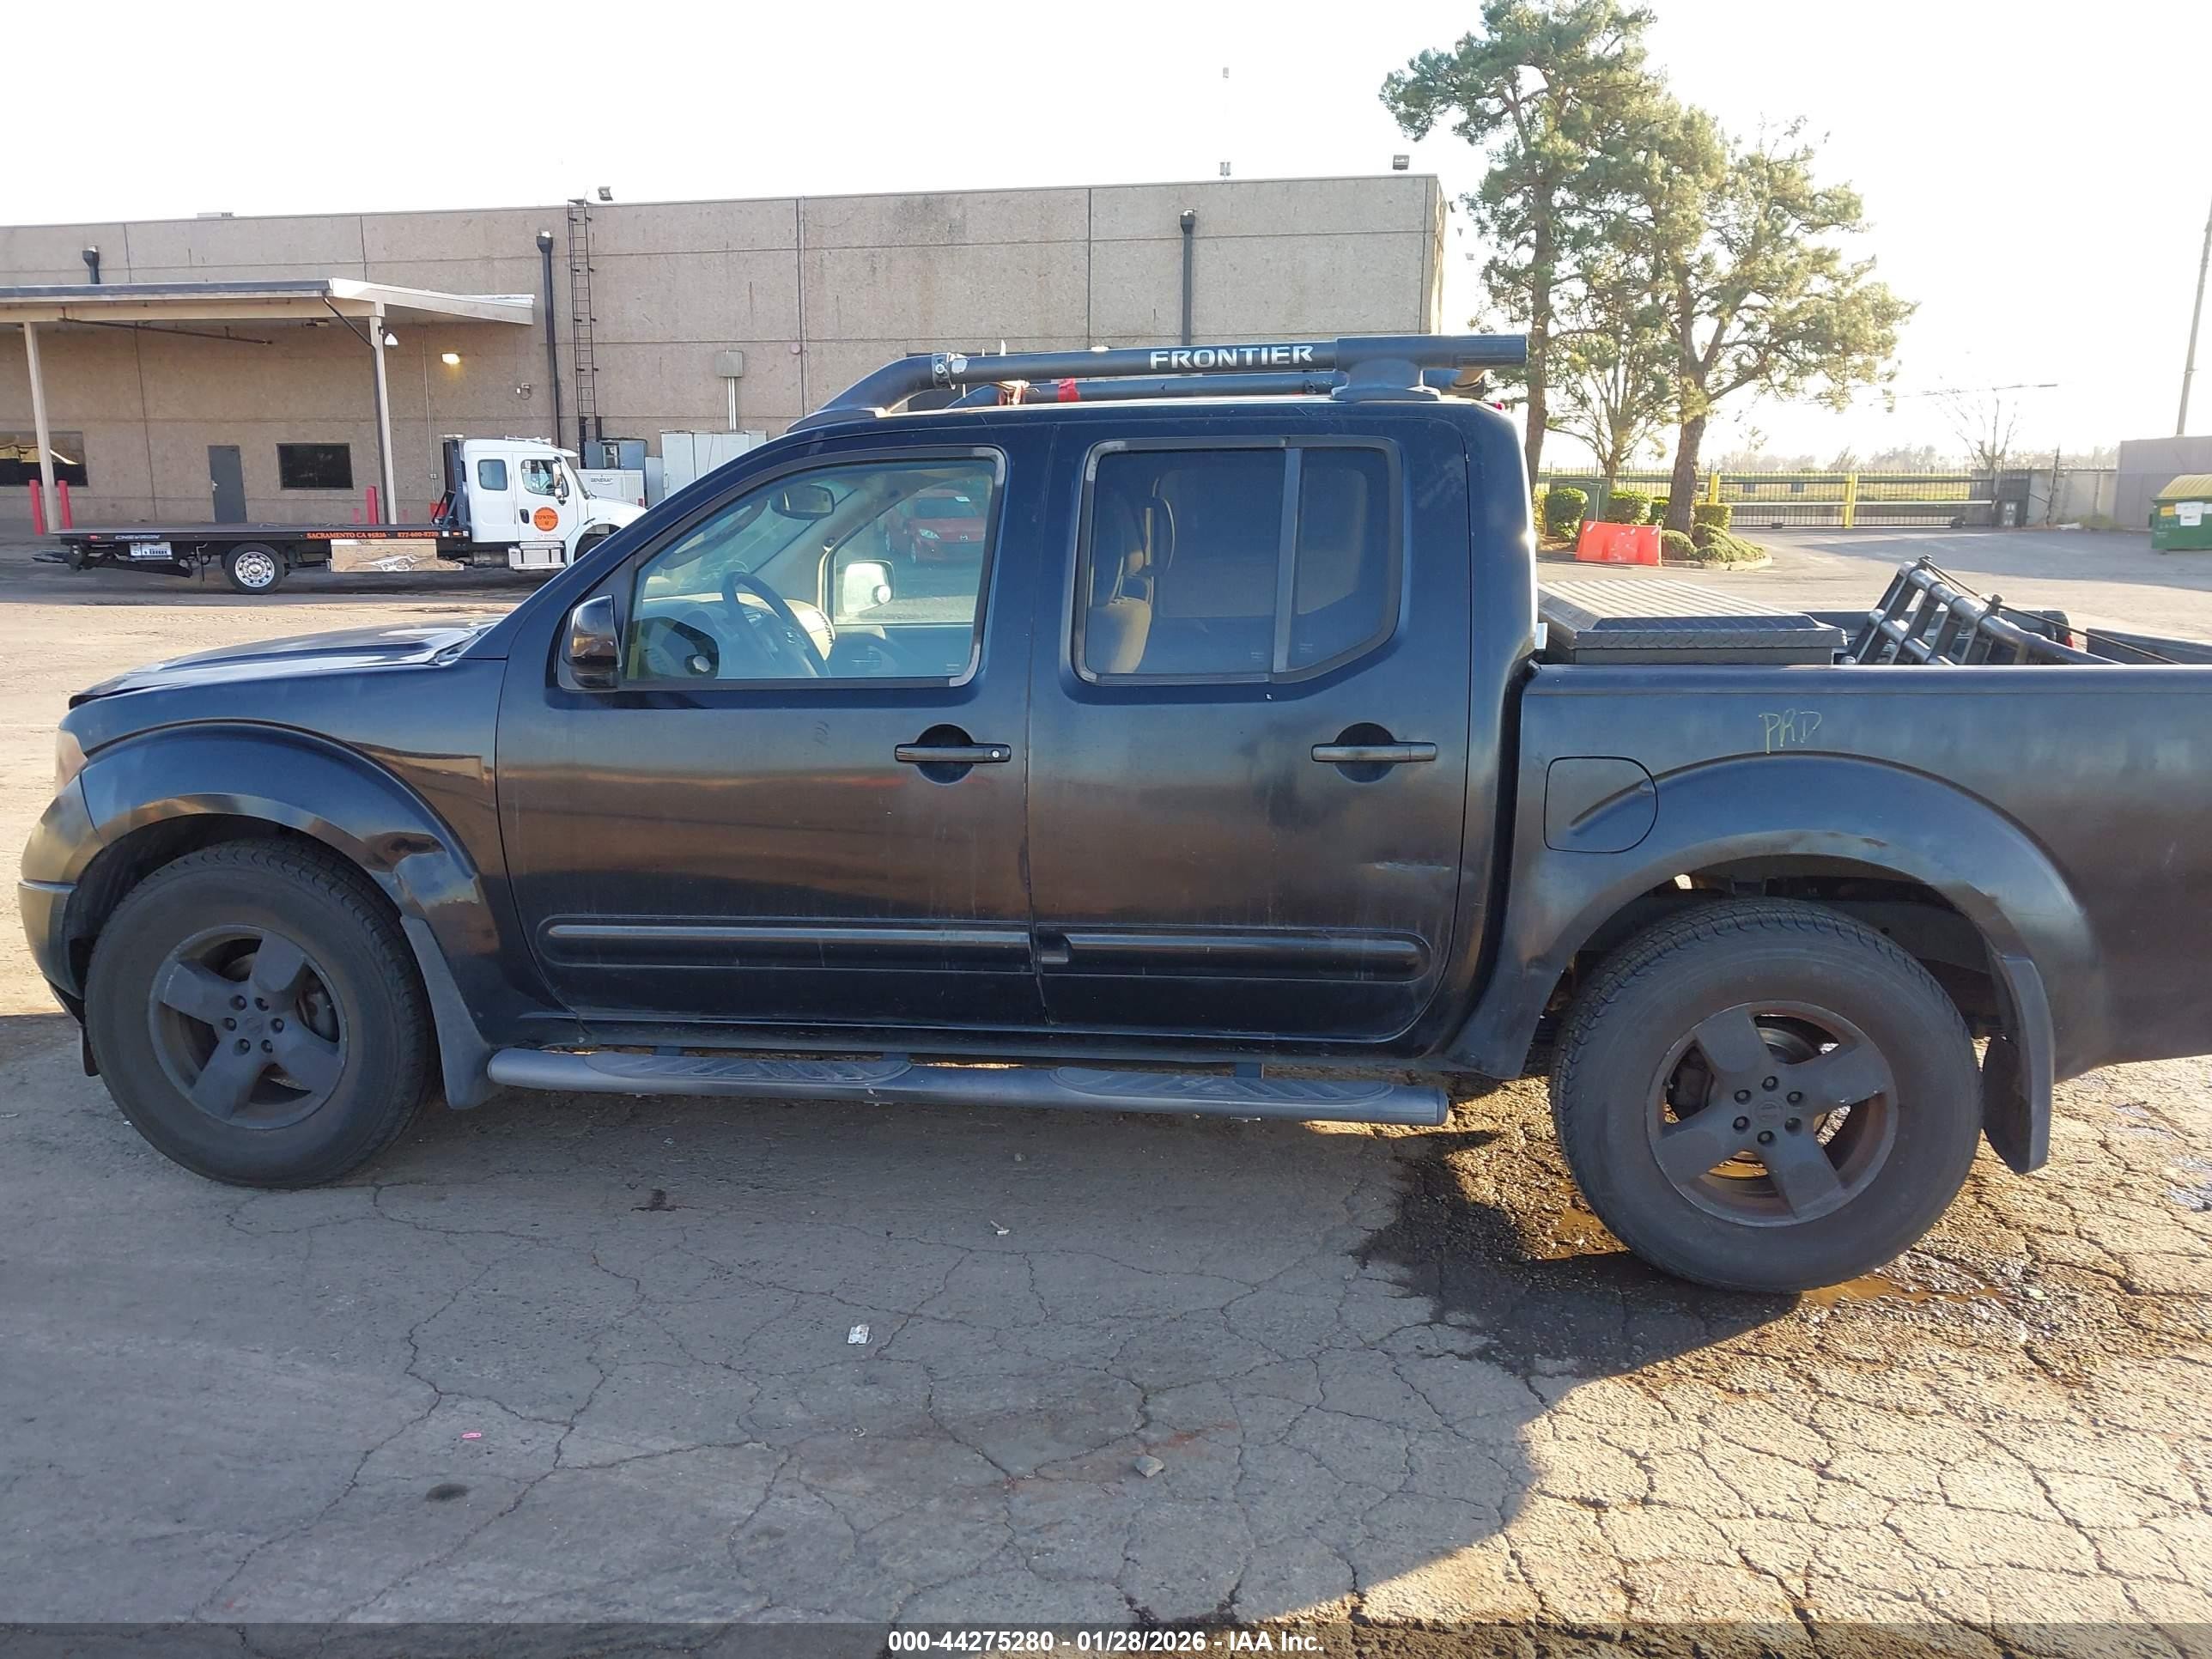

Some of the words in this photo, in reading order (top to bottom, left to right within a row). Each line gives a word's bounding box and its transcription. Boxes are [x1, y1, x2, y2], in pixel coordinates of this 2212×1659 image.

[1150, 345, 1314, 370] FRONTIER
[307, 532, 355, 540] SACRAMENTO
[1758, 708, 1823, 755] PRD
